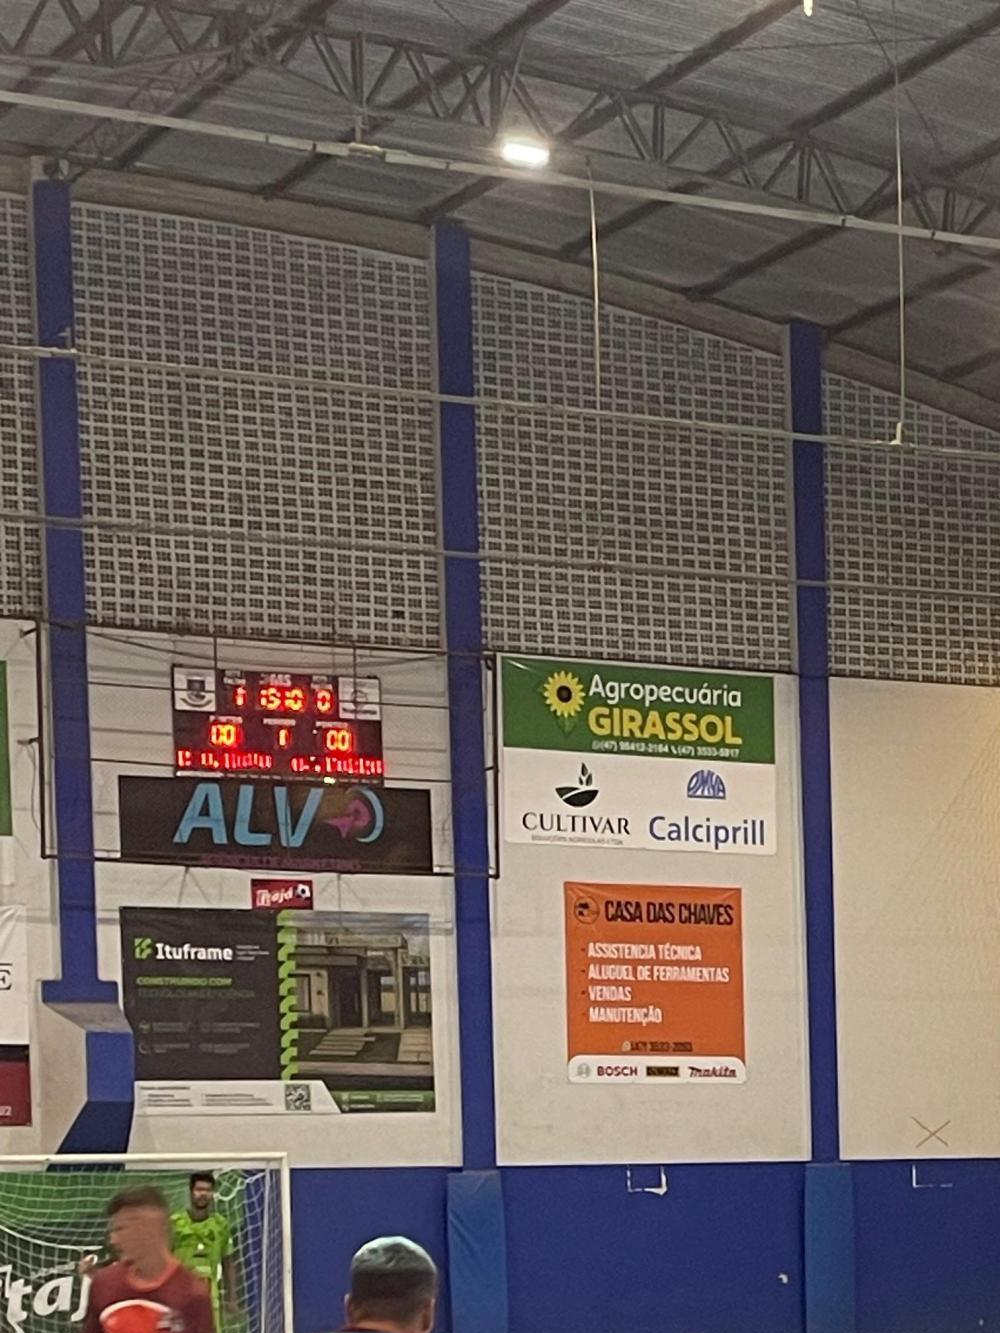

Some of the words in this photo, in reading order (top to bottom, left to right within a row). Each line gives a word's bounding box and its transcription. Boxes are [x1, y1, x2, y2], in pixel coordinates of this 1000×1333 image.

[588, 674, 742, 707] Agropecuária
[588, 707, 743, 745] GIRASSOL
[522, 812, 631, 835] CULTIVAR
[649, 815, 765, 850] Calciprill
[604, 900, 643, 923] CASA
[646, 902, 675, 924] DAS
[679, 903, 734, 926] CHAVES
[156, 943, 233, 960] Ituframe
[658, 943, 702, 961] TÉCNICA
[588, 964, 635, 981] ALUGUEL
[637, 966, 652, 981] DE
[653, 966, 730, 983] FERRAMENTAS
[588, 986, 632, 1001] VENDAS
[589, 1006, 663, 1026] MANUTENÇÃO
[597, 1065, 638, 1077] BOSCH
